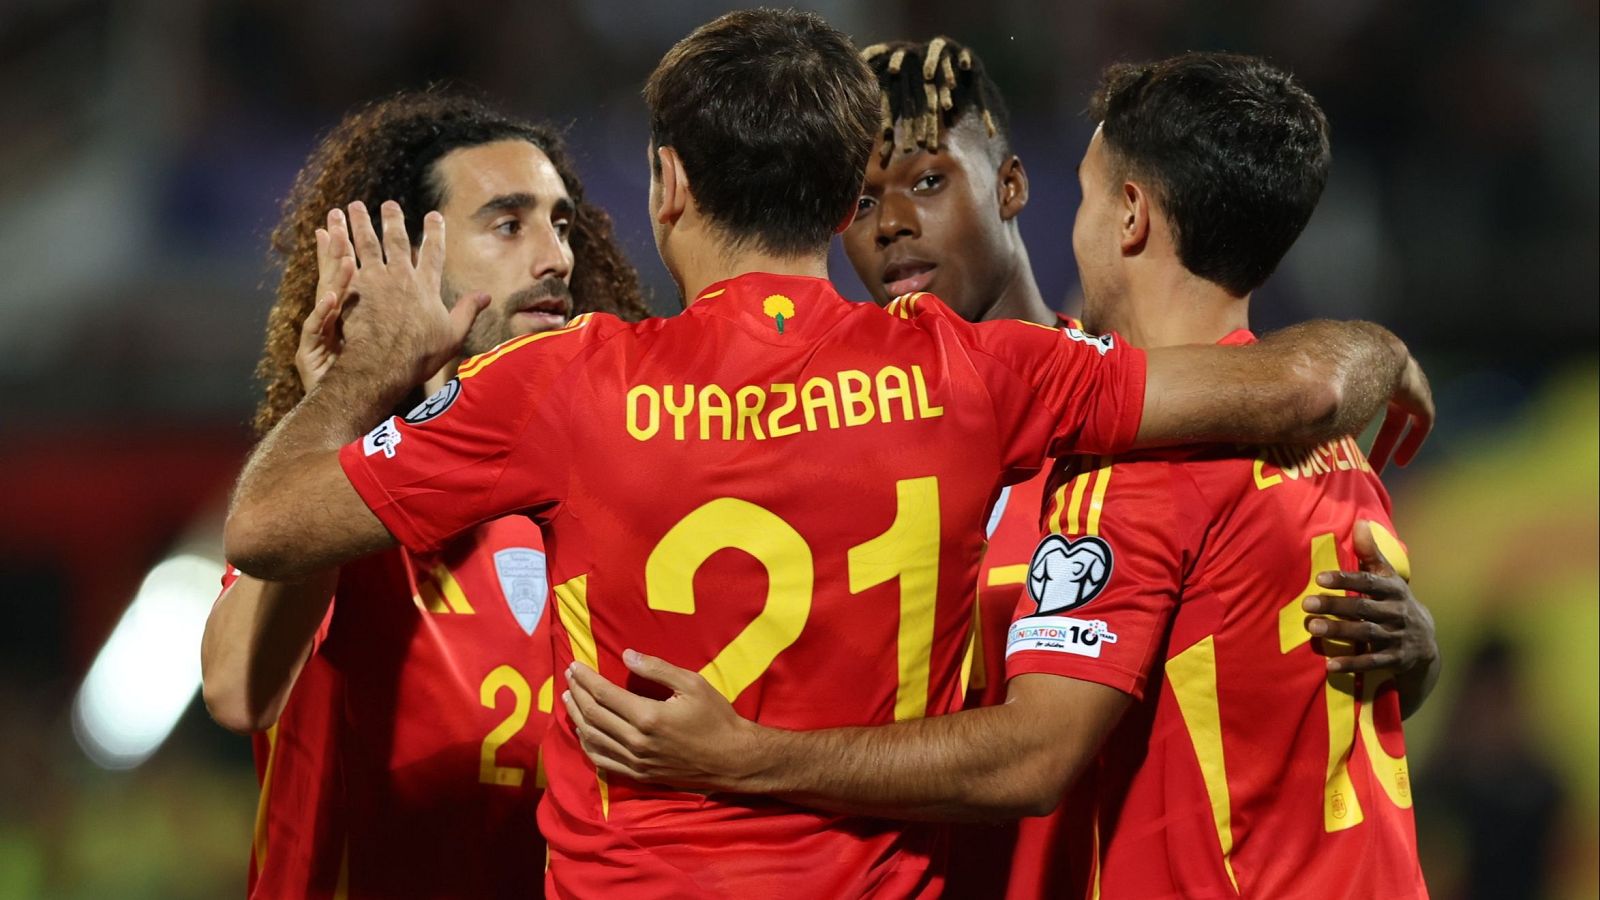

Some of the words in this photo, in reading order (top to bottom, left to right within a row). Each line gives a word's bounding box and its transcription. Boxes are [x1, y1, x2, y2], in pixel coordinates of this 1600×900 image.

[626, 365, 944, 441] OYARZABAL
[645, 476, 941, 722] 21
[1069, 626, 1099, 646] 10
